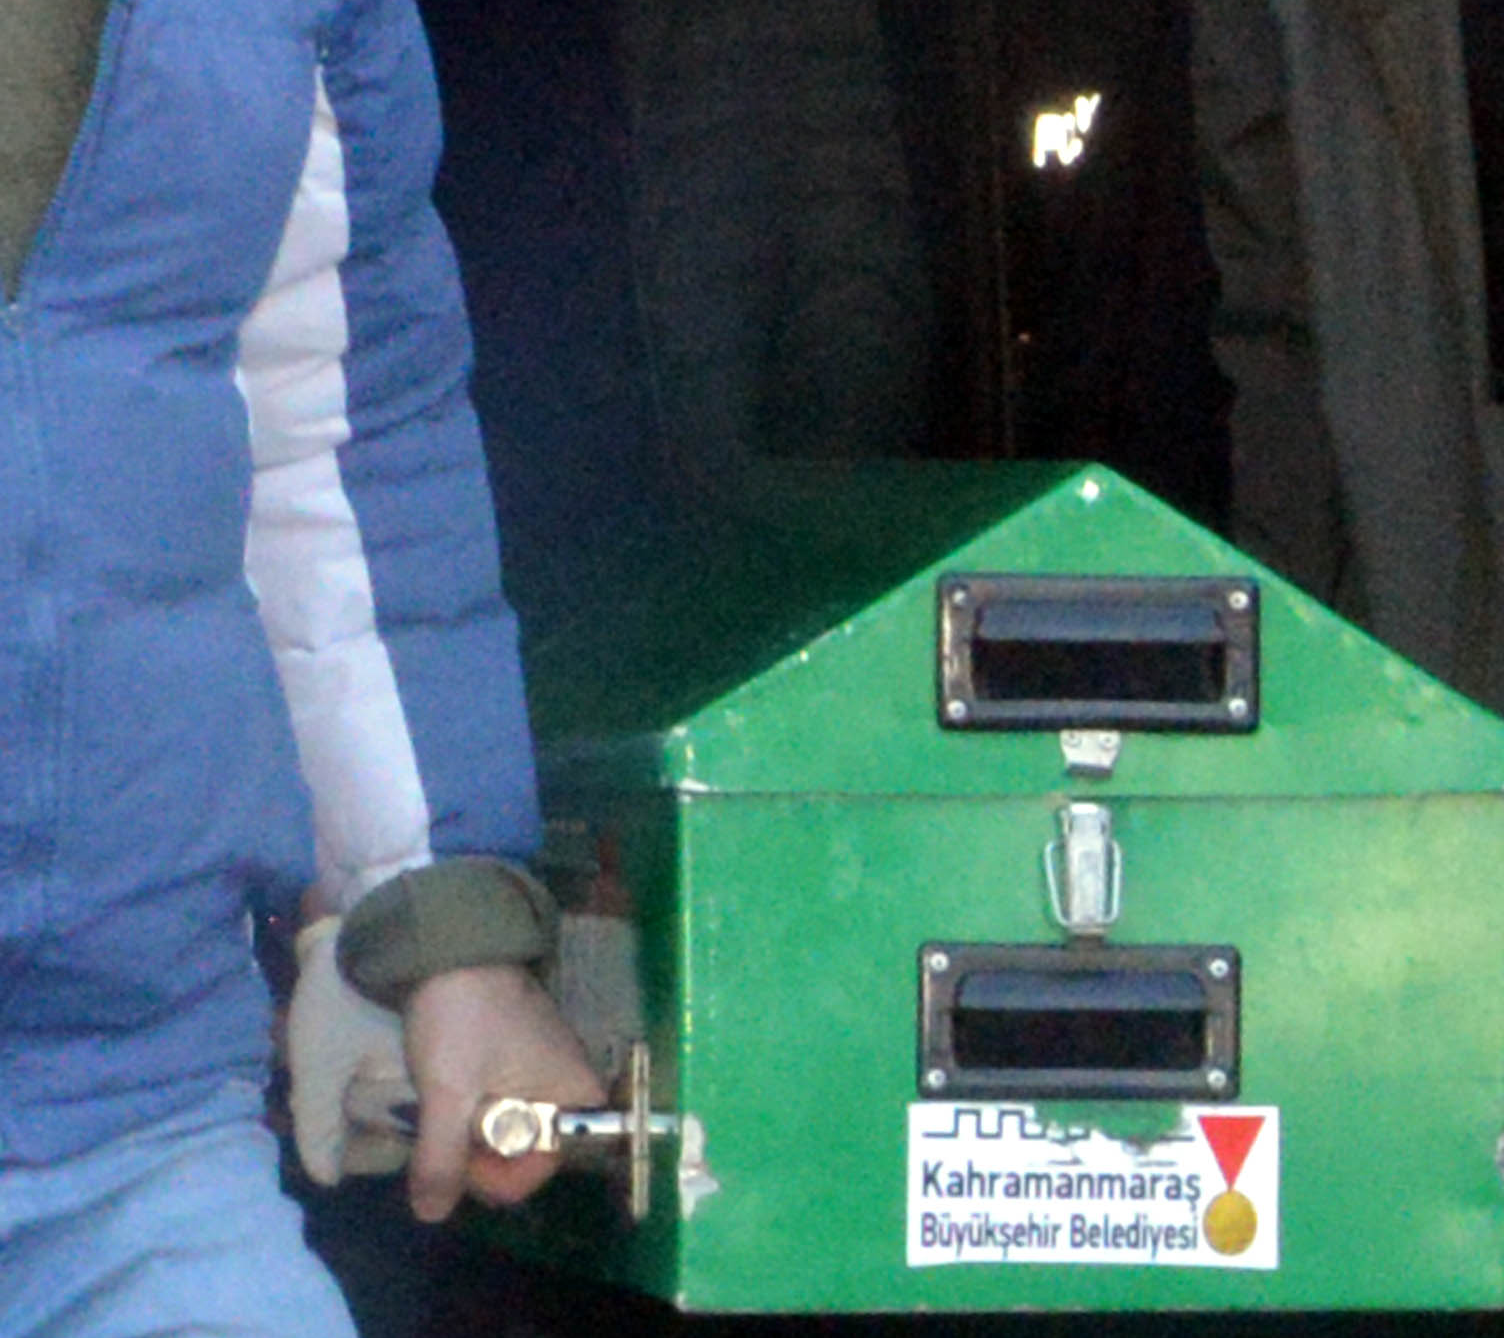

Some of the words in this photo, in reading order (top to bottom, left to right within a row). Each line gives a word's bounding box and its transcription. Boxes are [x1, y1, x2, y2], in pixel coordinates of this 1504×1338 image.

[921, 1160, 1201, 1213] Kahramanmaraş
[920, 1211, 1062, 1260] Büyükşehir
[1069, 1213, 1199, 1260] Belediyesi
